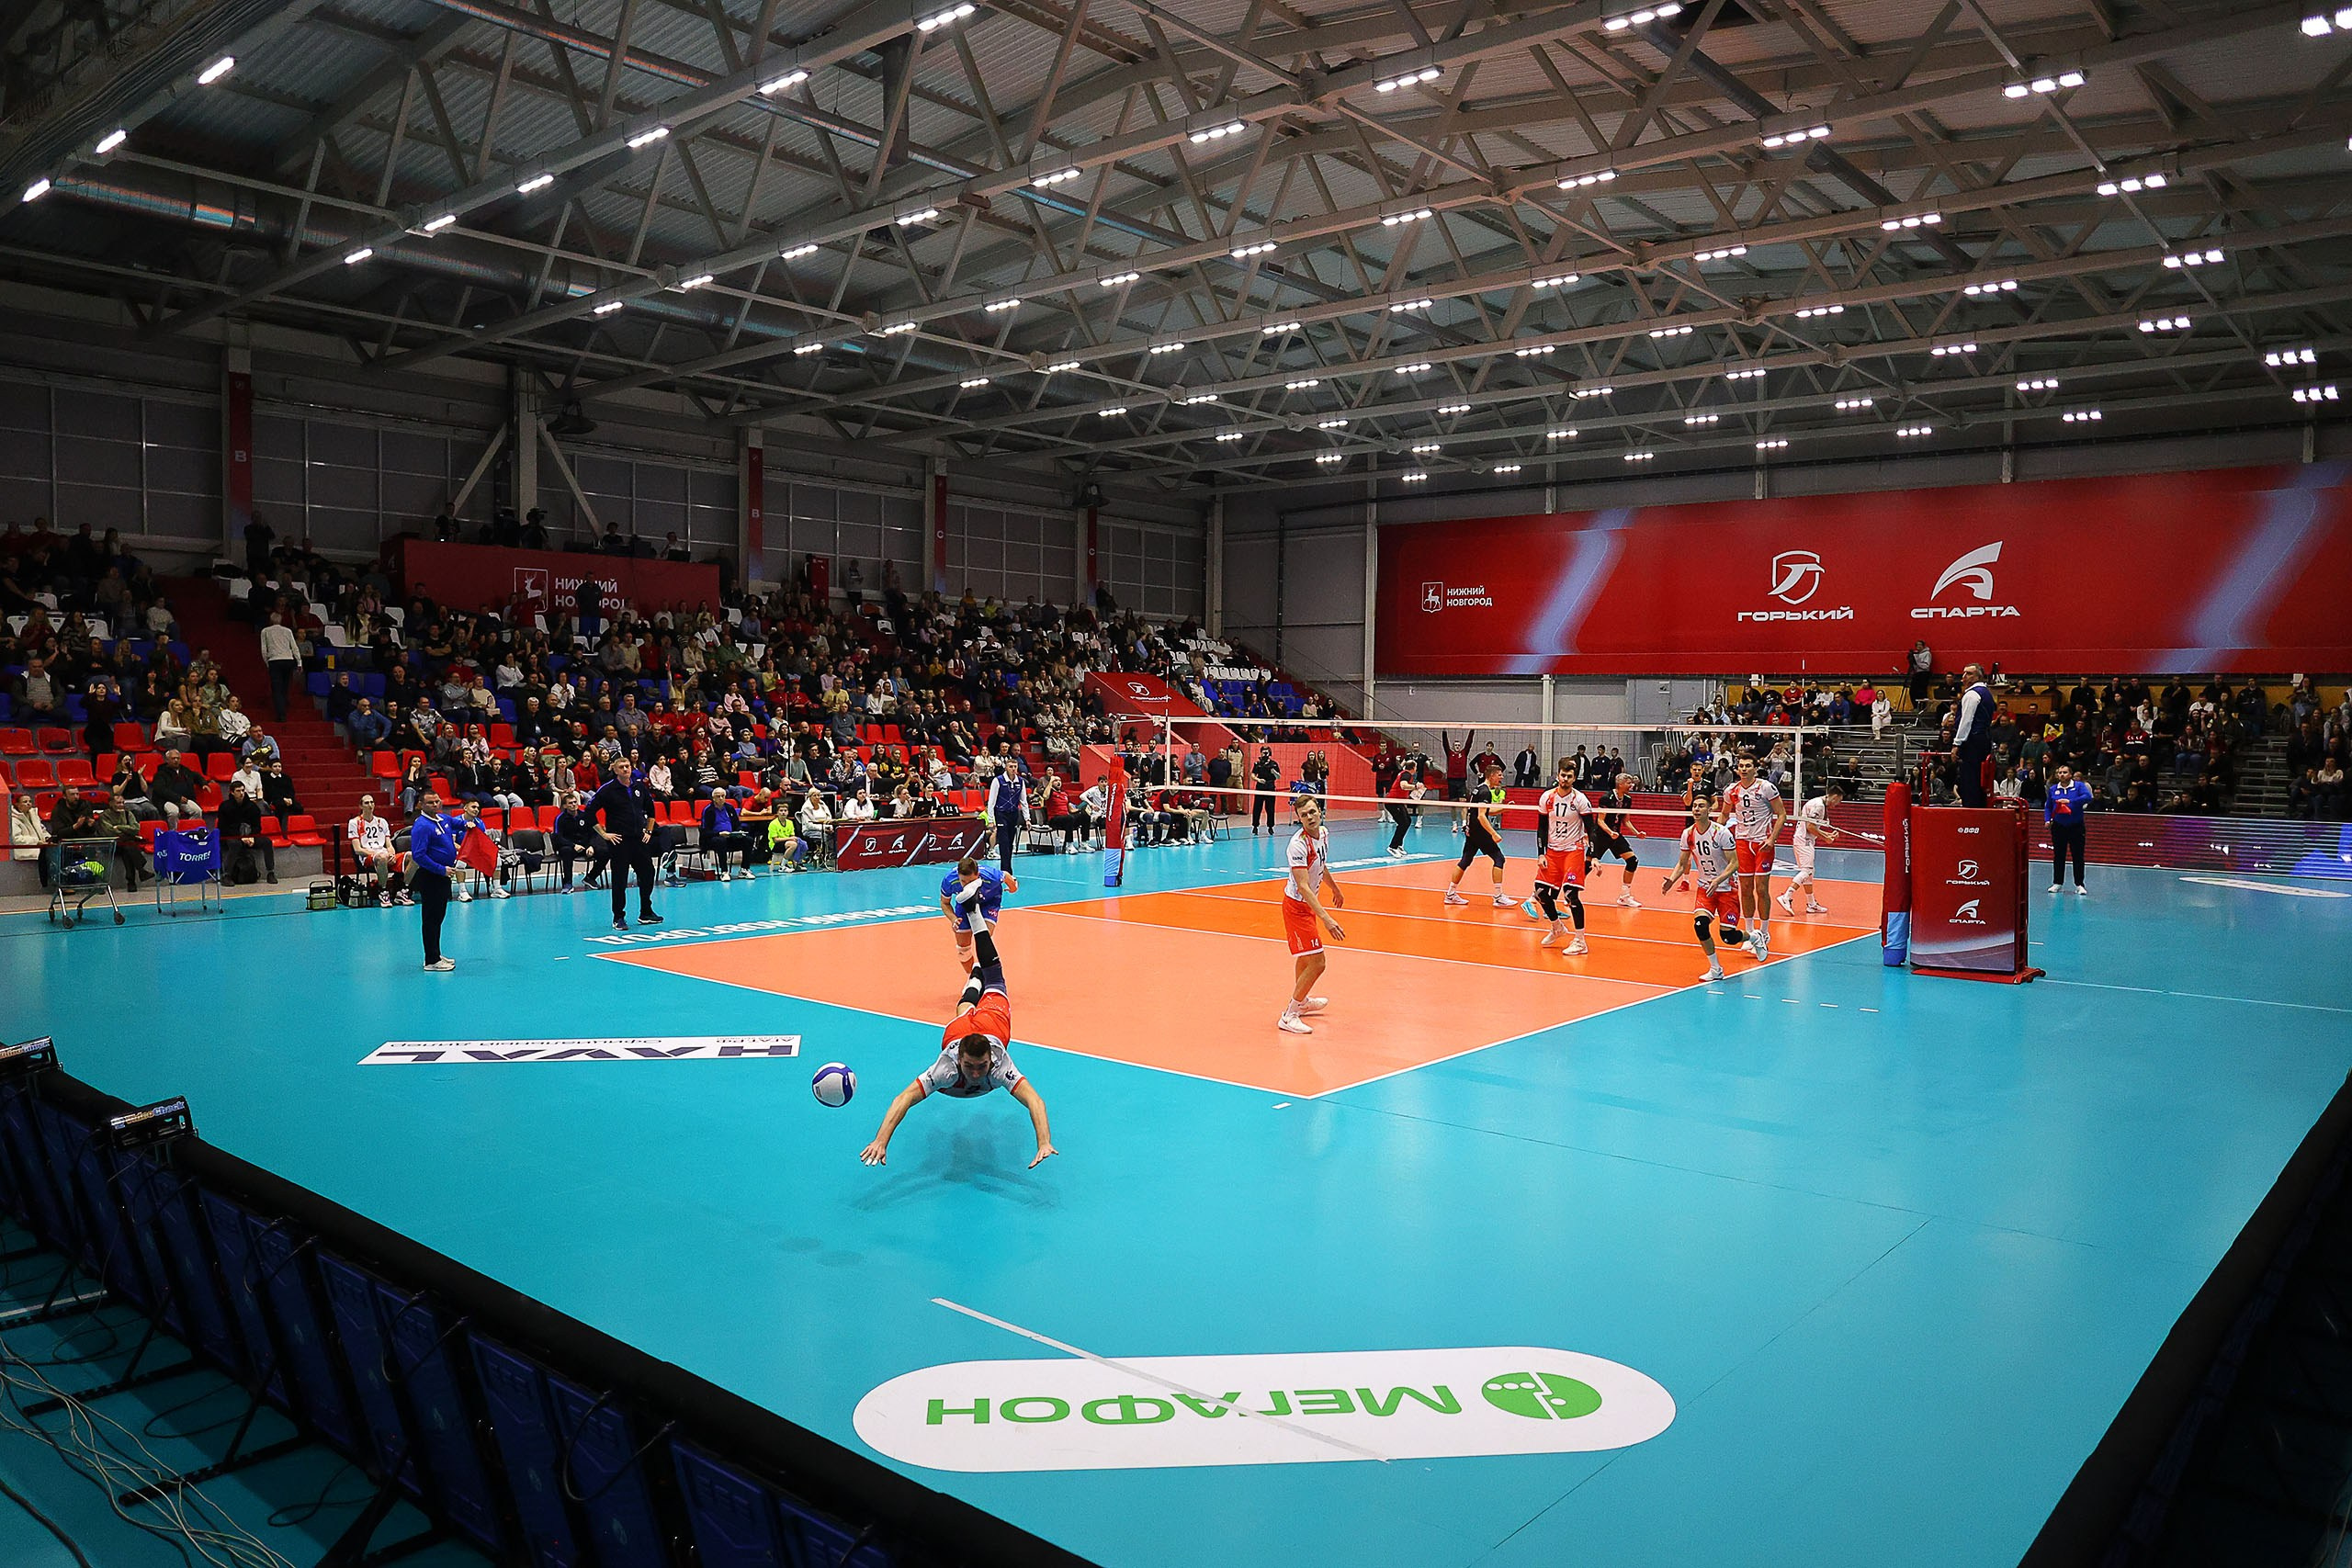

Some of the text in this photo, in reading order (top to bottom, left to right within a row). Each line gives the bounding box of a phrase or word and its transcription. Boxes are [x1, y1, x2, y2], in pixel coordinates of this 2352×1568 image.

[1446, 584, 1485, 595] НИЖНИЙ
[1446, 598, 1493, 607] НОВГОРОД
[1737, 605, 1854, 622] ГОРЬКИЙ
[1910, 605, 2021, 618] СПАРТА
[1743, 794, 1750, 808] 6
[1555, 802, 1567, 817] 17
[366, 827, 379, 839] 22
[1696, 840, 1711, 856] 16
[1902, 818, 1911, 874] ГОРЬКИЙ
[1310, 938, 1319, 948] 14
[376, 1045, 794, 1062] HAVAL
[926, 1385, 1463, 1426] МЕГАФОН
